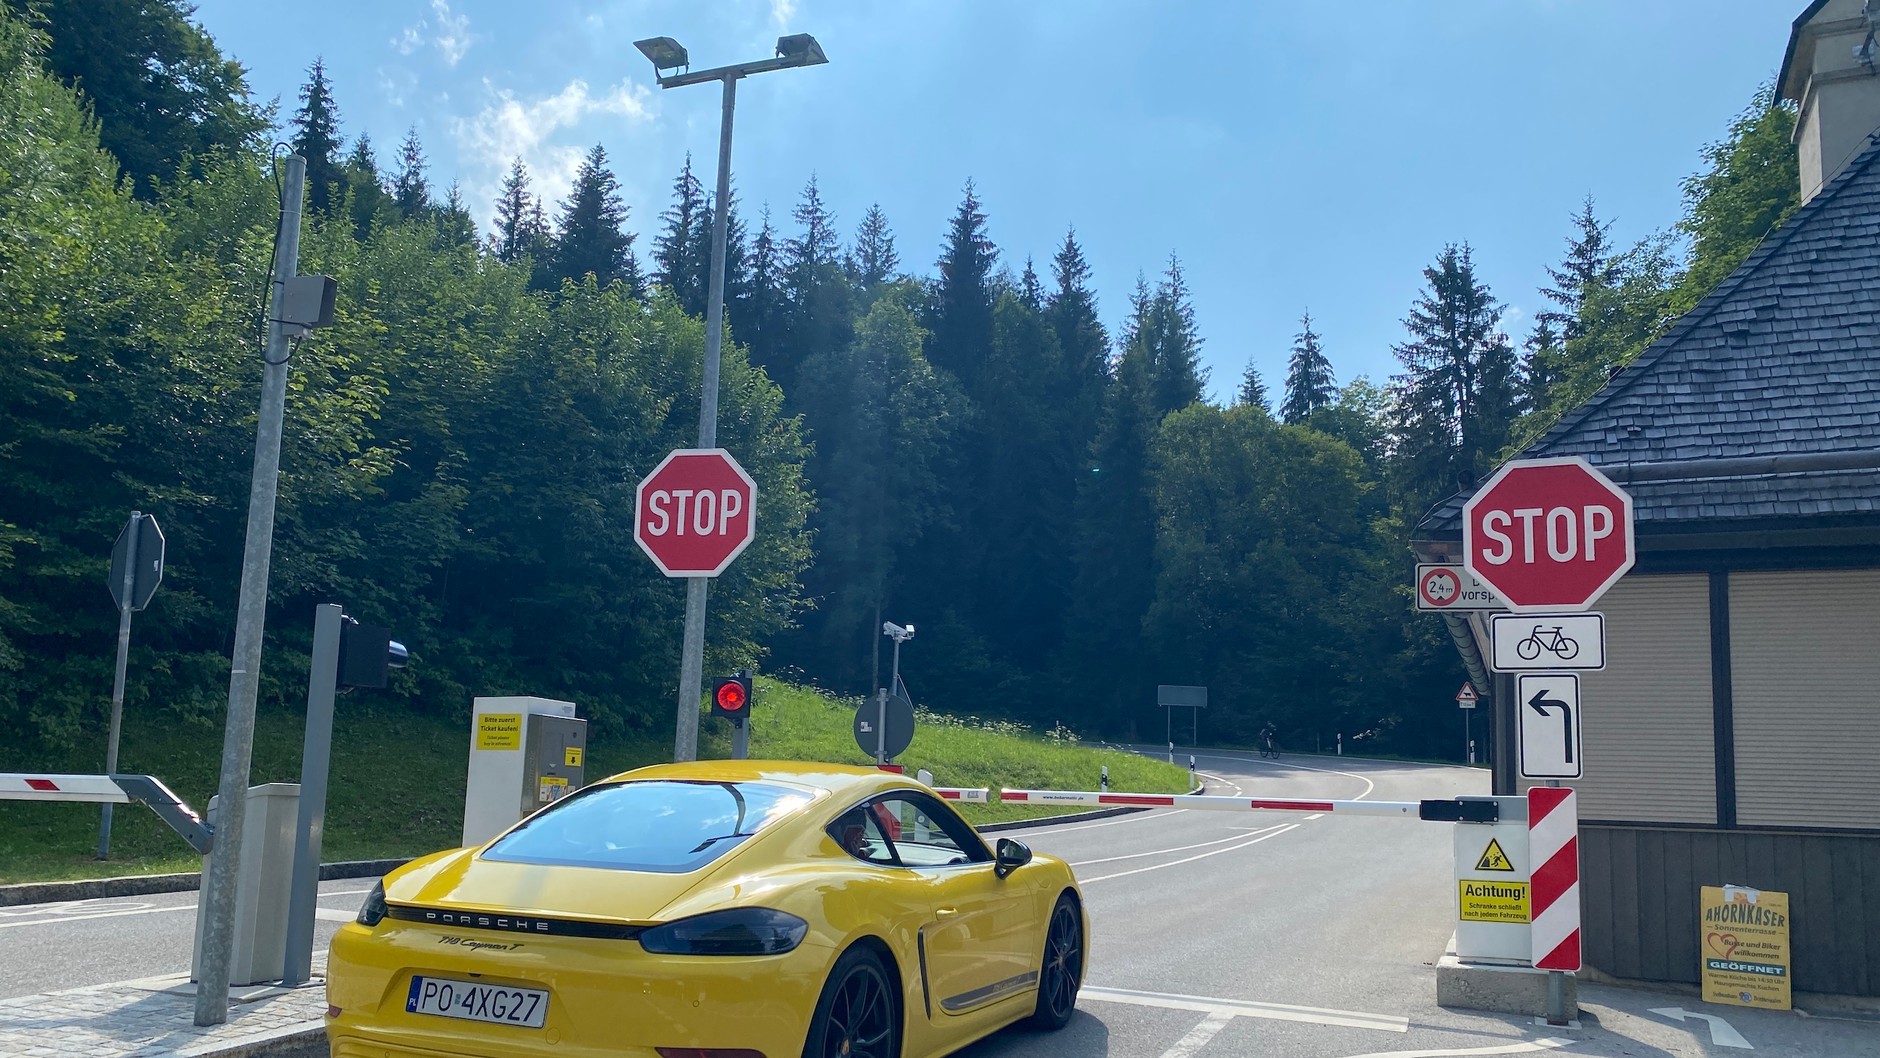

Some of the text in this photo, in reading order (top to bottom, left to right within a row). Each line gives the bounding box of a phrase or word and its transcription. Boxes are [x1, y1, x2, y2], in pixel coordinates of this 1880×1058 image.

[647, 489, 742, 536] STOP
[1482, 505, 1614, 565] STOP
[1462, 591, 1498, 603] vorsp
[1465, 884, 1526, 901] Achtung!
[1469, 902, 1498, 910] Schranke
[426, 912, 549, 931] PORSCHE
[1499, 912, 1527, 920] Fahrzeug
[1705, 903, 1786, 928] AHORNKASER
[1714, 924, 1777, 935] Sonnenterrasse
[438, 936, 525, 951] 718 Cayman T
[1745, 940, 1761, 948] und
[1761, 942, 1782, 950] Biker
[1734, 949, 1780, 960] willkommen
[1709, 961, 1783, 975] GEÖFFNET
[408, 998, 417, 1007] PL
[422, 982, 541, 1022] PO 4XG27
